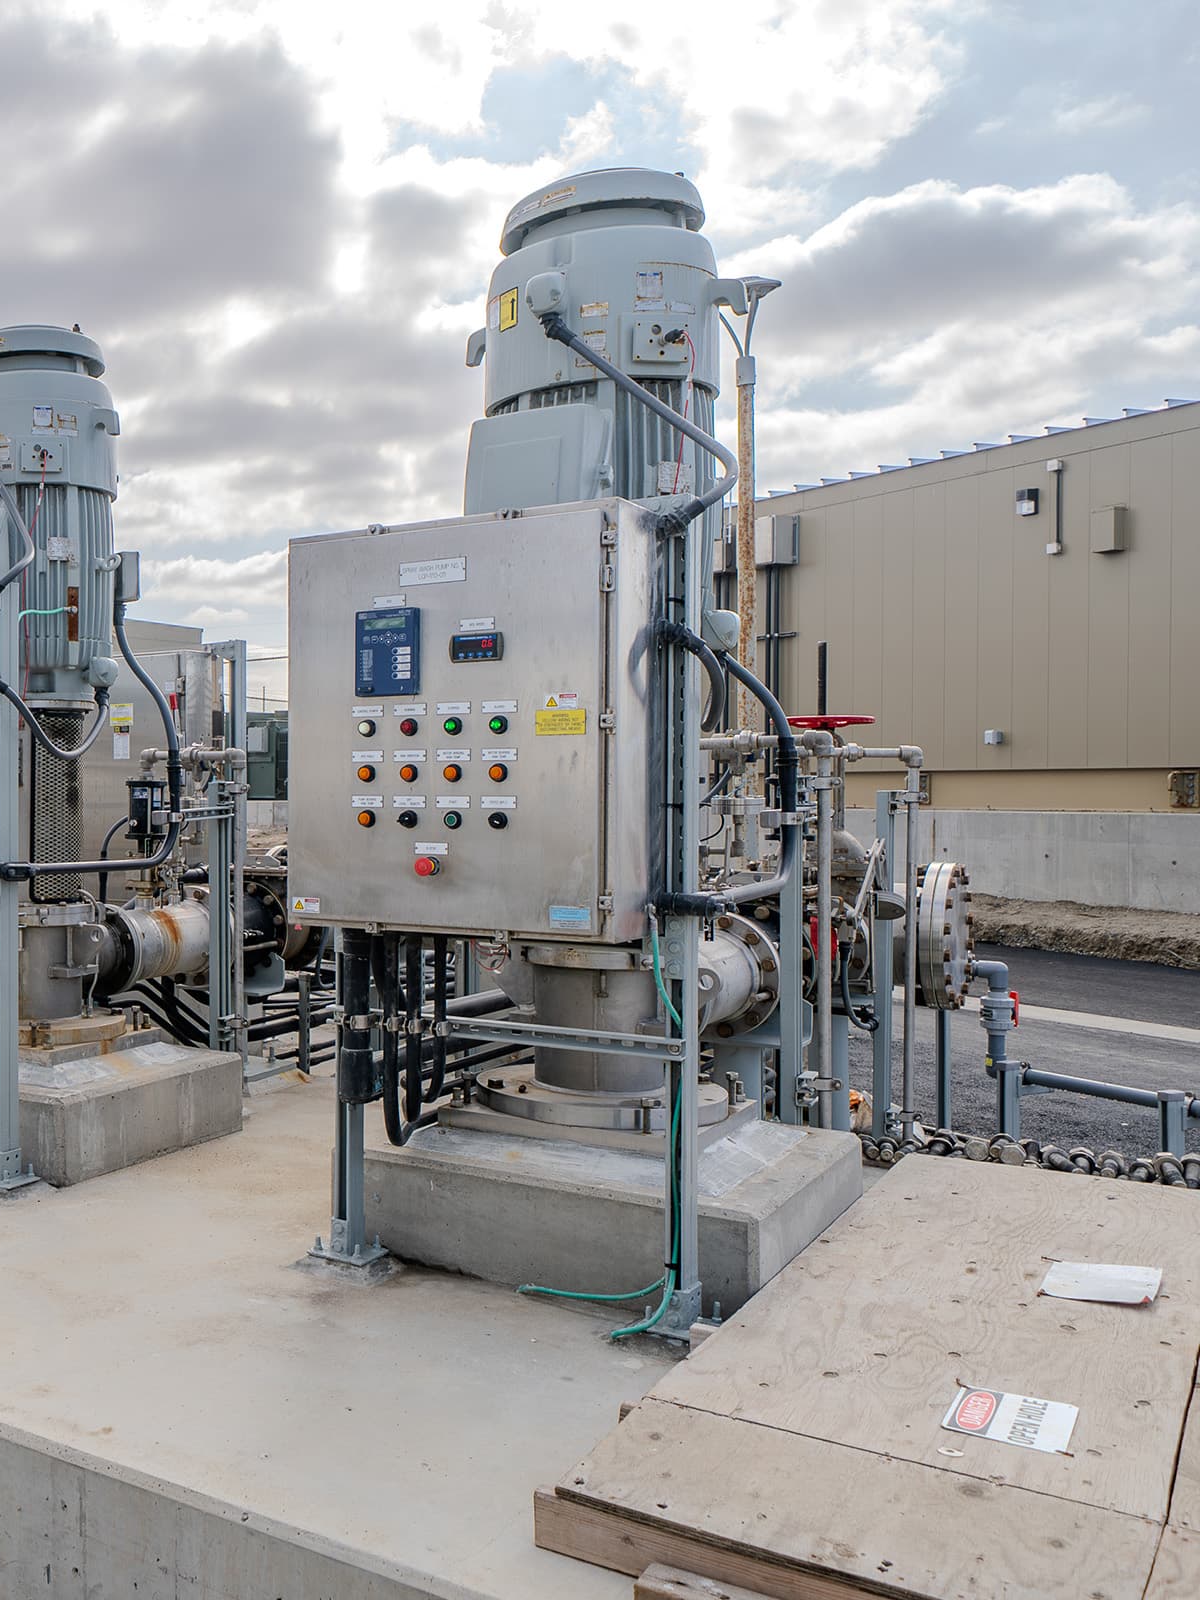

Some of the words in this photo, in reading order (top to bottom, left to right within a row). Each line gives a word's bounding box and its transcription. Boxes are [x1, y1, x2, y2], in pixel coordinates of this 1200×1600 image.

[959, 1395, 993, 1426] DANGER
[1016, 1398, 1048, 1422] HOLE
[1007, 1419, 1041, 1445] OPEN
